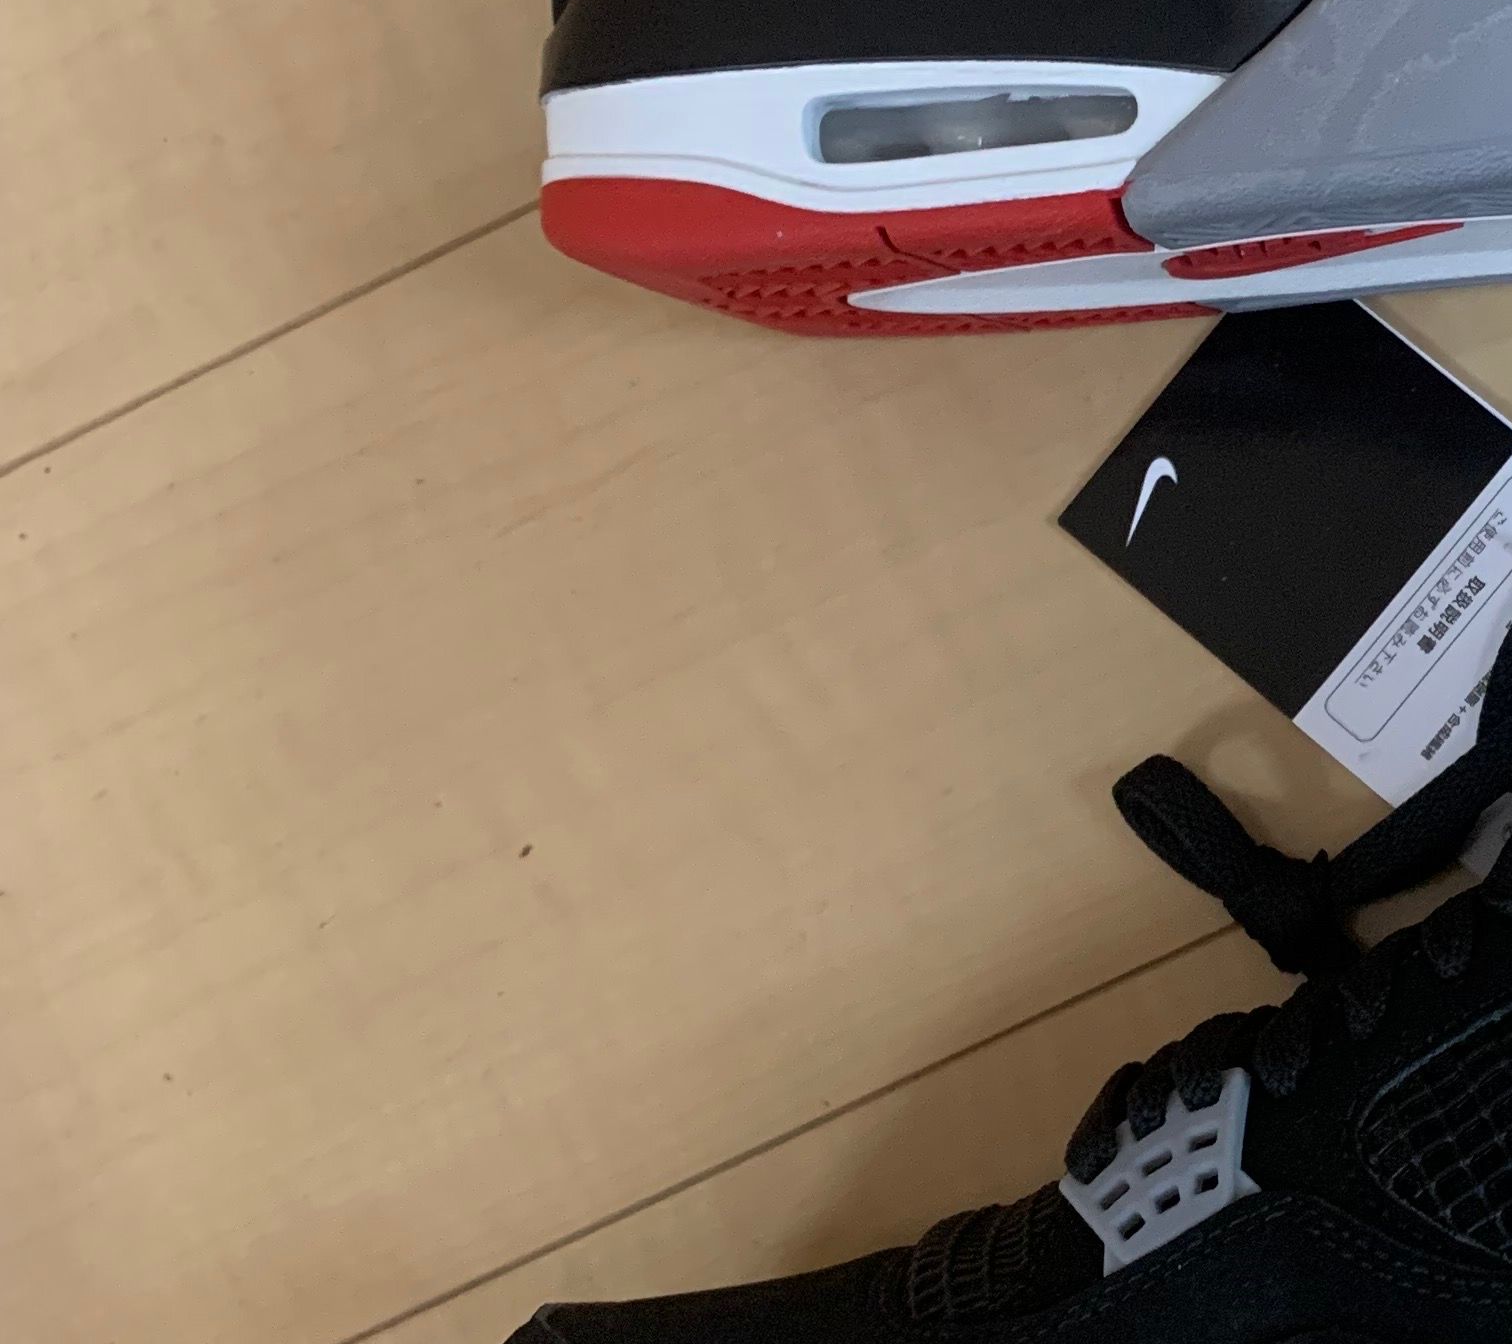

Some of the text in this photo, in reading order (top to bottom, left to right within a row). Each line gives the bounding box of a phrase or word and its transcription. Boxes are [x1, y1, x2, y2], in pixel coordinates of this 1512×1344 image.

[1356, 509, 1509, 691] ご使用前に必ずお読み下さい
[1415, 574, 1486, 655] 取扱説明書
